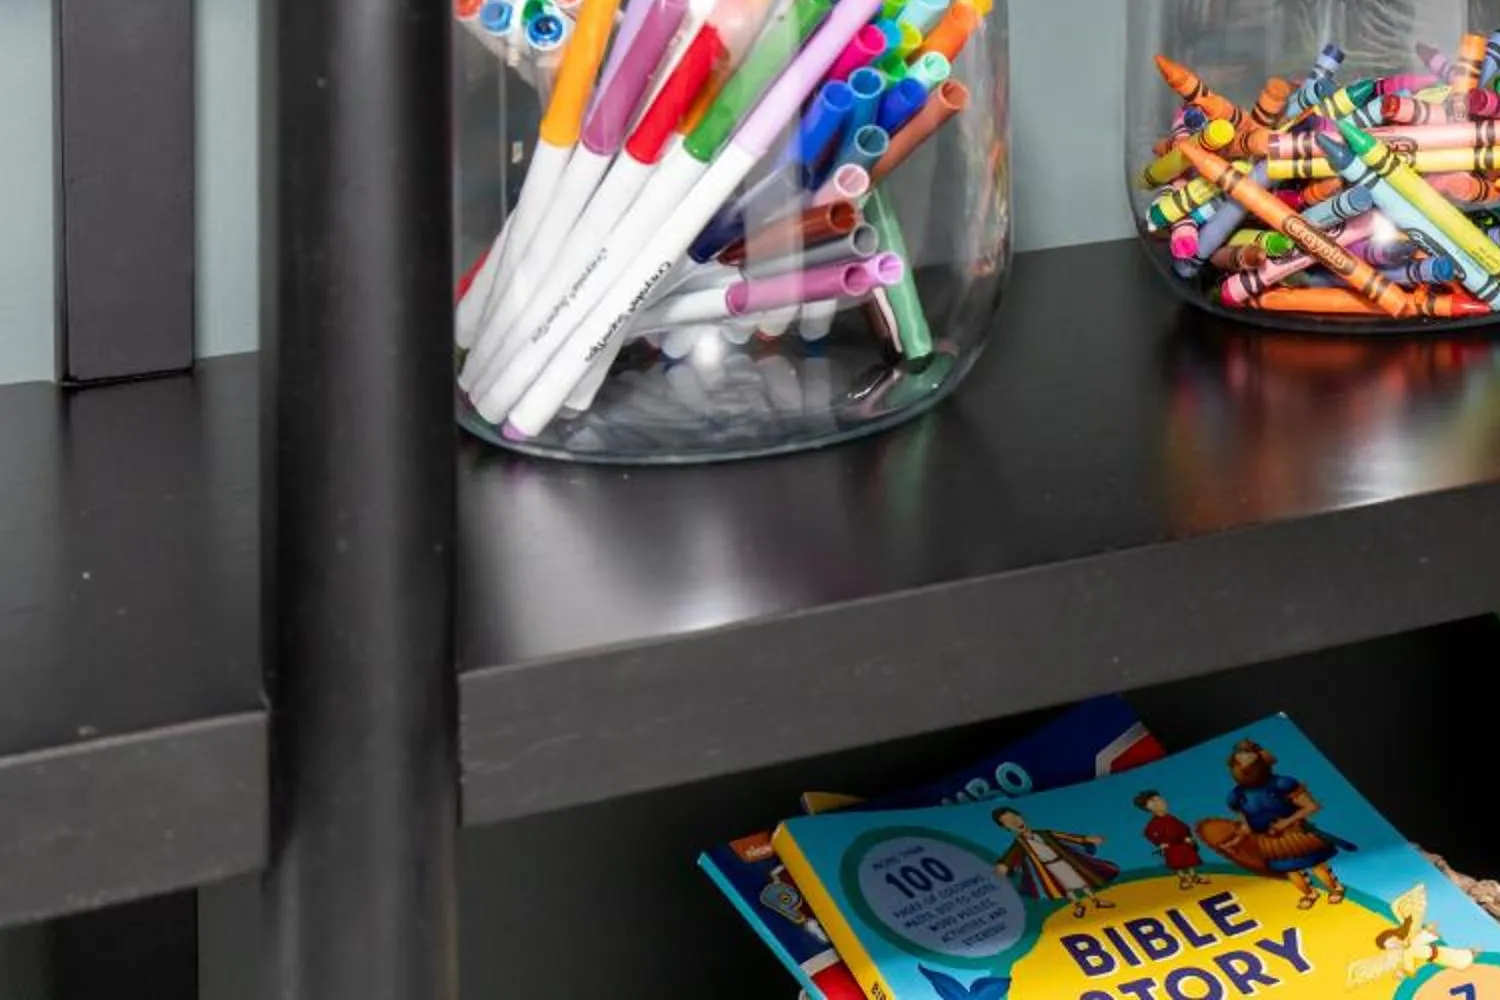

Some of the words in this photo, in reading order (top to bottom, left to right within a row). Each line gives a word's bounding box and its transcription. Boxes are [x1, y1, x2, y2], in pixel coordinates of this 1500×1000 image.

[885, 857, 955, 899] 100
[1060, 891, 1259, 976] BIBLE
[1080, 927, 1312, 1000] TORY
